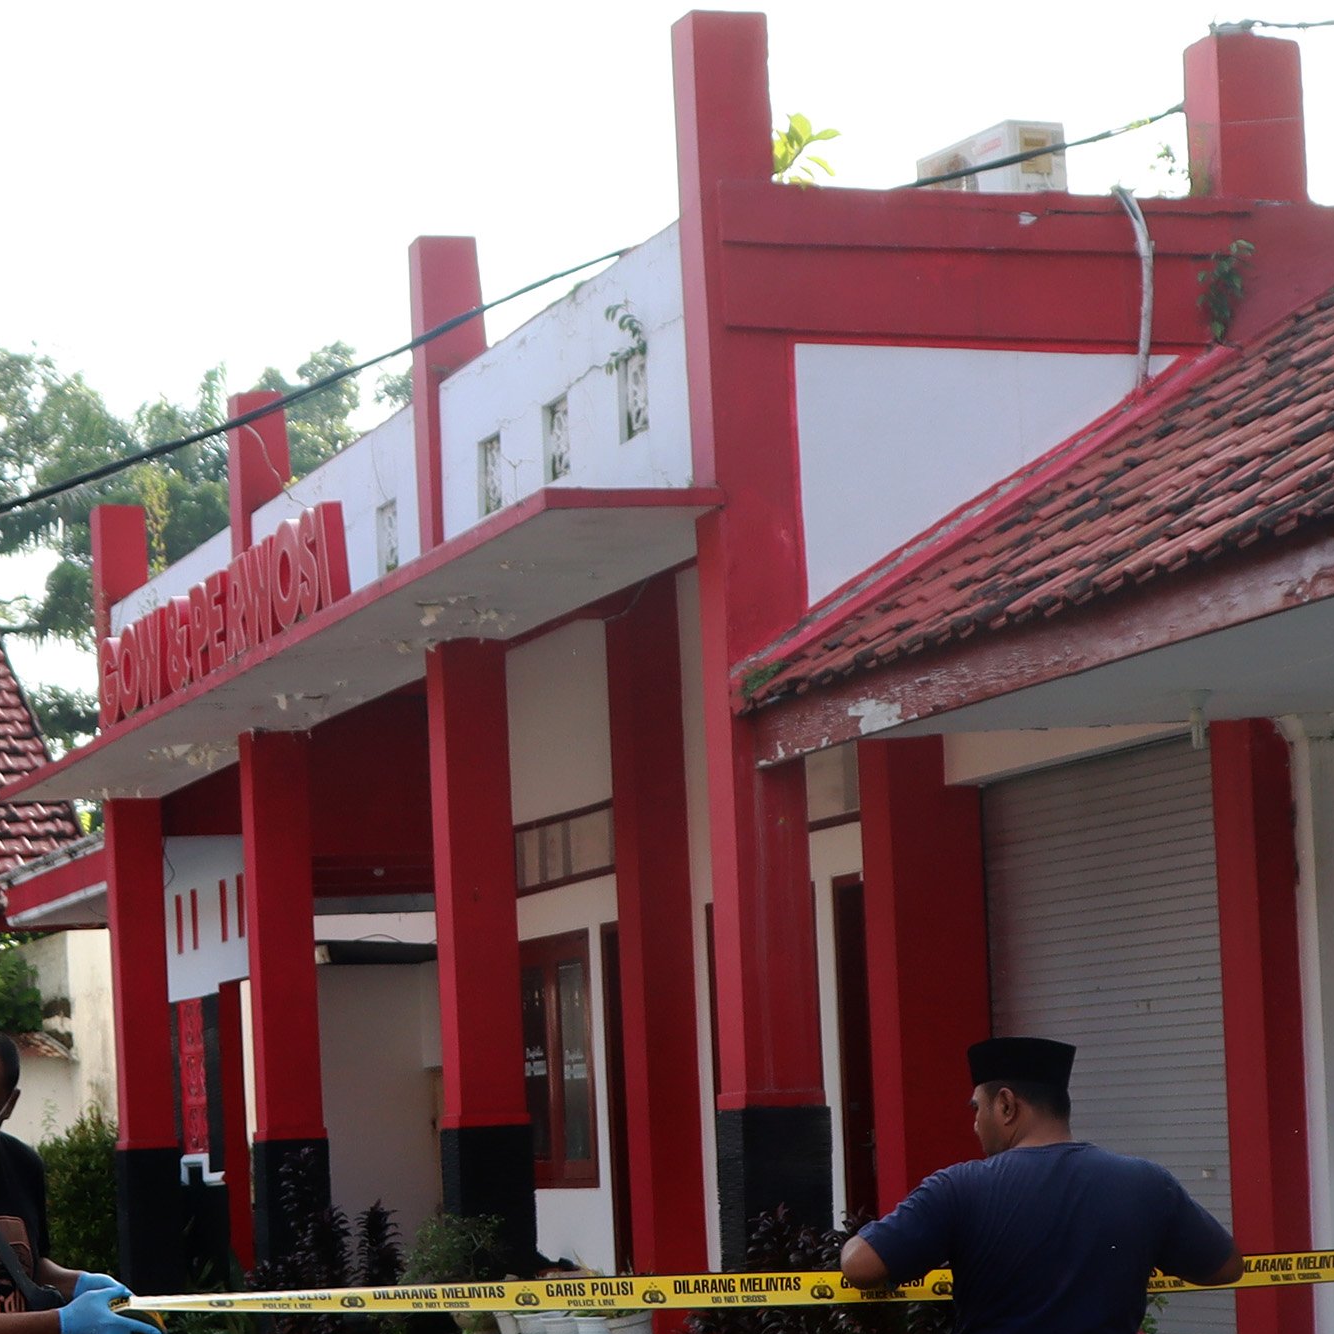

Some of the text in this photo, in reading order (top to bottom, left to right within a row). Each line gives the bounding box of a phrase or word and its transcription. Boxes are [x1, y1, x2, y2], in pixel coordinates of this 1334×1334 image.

[100, 605, 166, 727] GOW
[188, 501, 351, 684] PERWOSI
[1244, 1257, 1292, 1273] ILARANG
[545, 1281, 634, 1297] GARIS POLISI
[673, 1277, 801, 1294] DILARANG MELINTAS
[1147, 1280, 1168, 1289] OLICE
[373, 1285, 505, 1300] DILARANG MELINTAS
[860, 1291, 887, 1300] POLICE
[567, 1298, 616, 1307] POLICE LINE
[711, 1295, 768, 1304] DO NOT CROSS
[262, 1302, 291, 1310] POLICE
